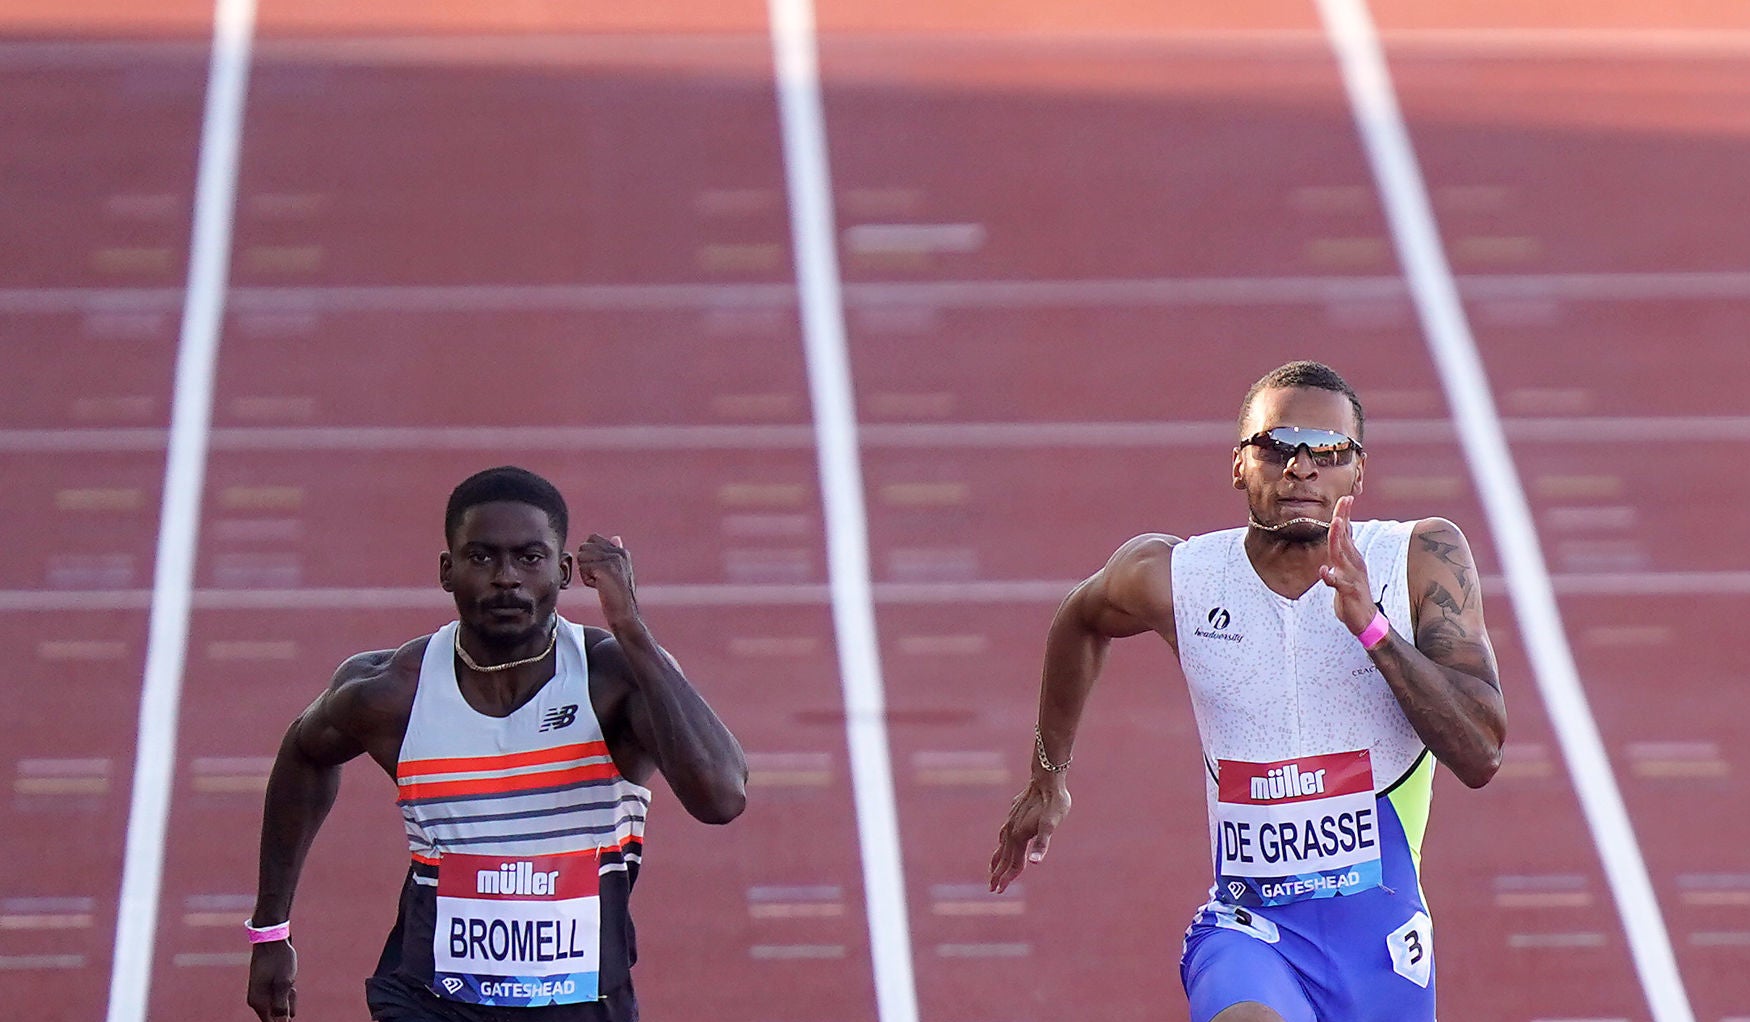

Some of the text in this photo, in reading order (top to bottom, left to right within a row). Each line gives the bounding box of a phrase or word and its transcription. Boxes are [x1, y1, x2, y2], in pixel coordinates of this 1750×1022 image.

[1250, 764, 1326, 801] müller
[1223, 808, 1375, 864] DE GRASSE
[477, 861, 559, 896] müller
[1261, 871, 1360, 899] GATESHEAD
[450, 916, 585, 963] BROMELL
[1404, 929, 1424, 966] 3
[480, 980, 576, 999] GATESHEAD
